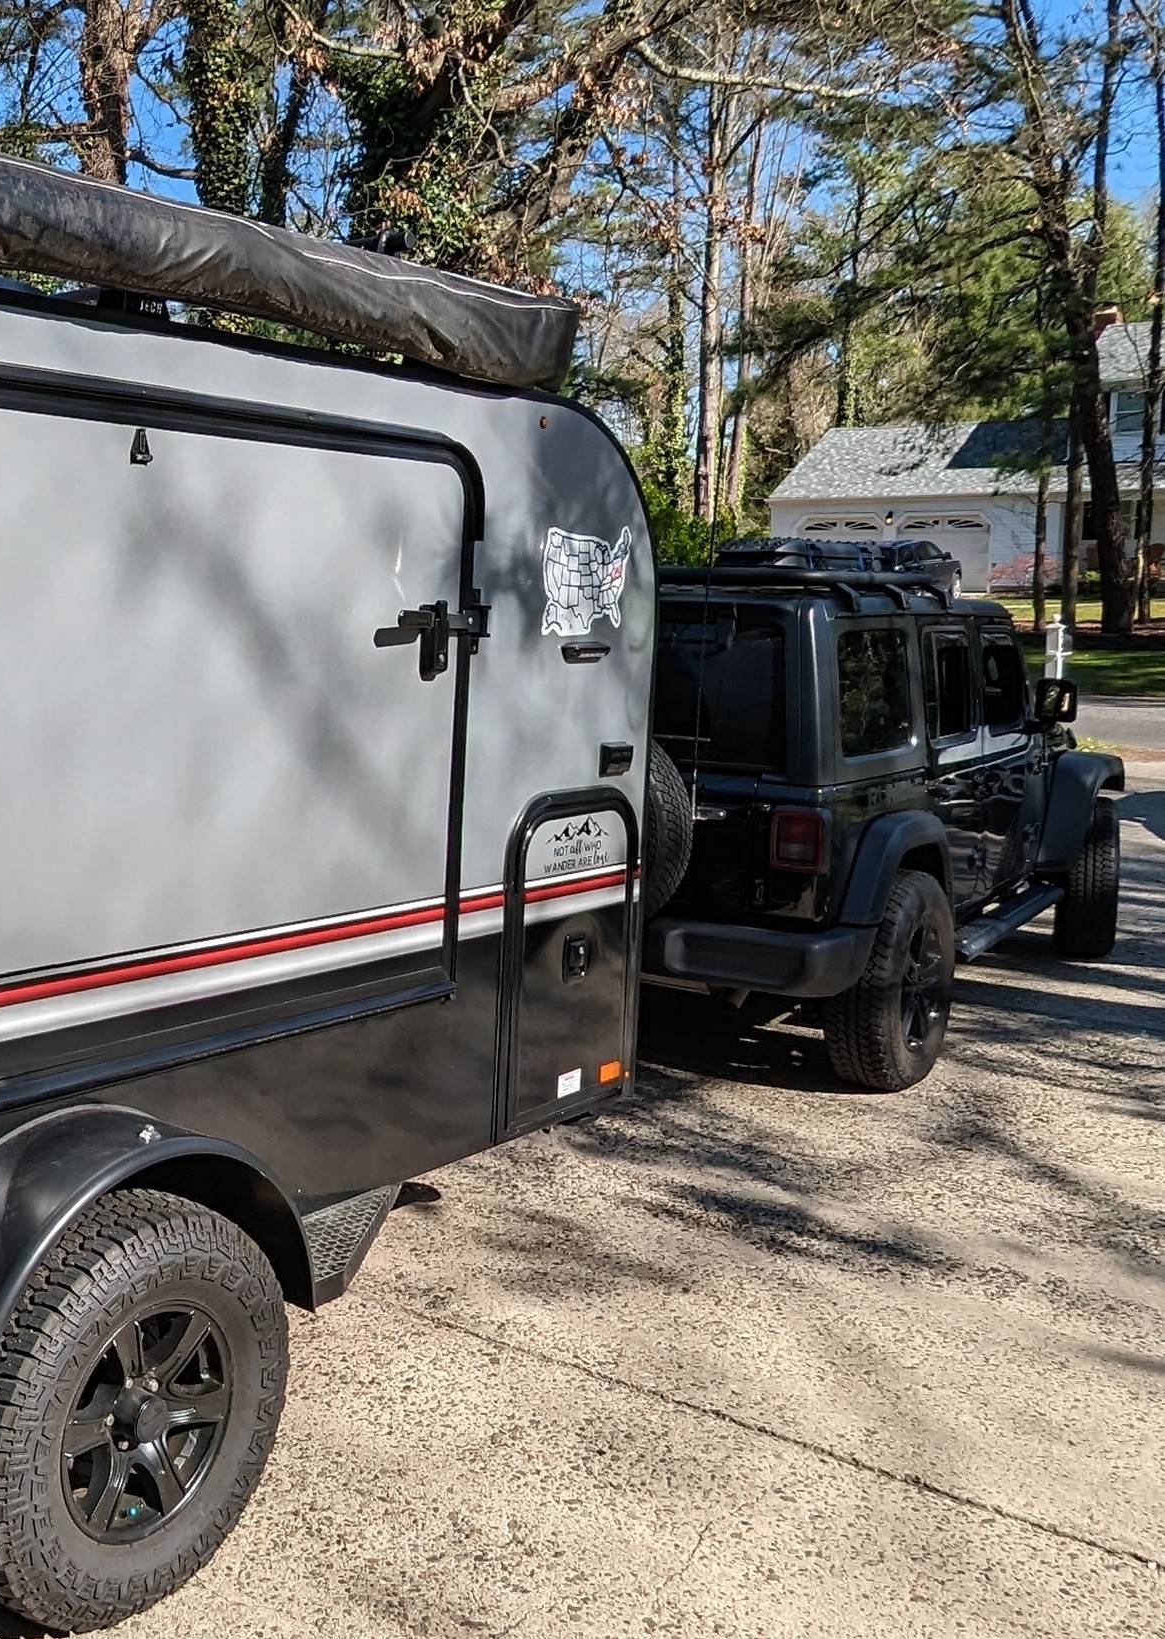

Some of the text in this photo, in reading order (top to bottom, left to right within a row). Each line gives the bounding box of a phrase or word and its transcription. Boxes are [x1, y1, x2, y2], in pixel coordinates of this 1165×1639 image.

[554, 845, 569, 857] NOT
[584, 840, 602, 852] WHO
[544, 859, 577, 872] WANDER
